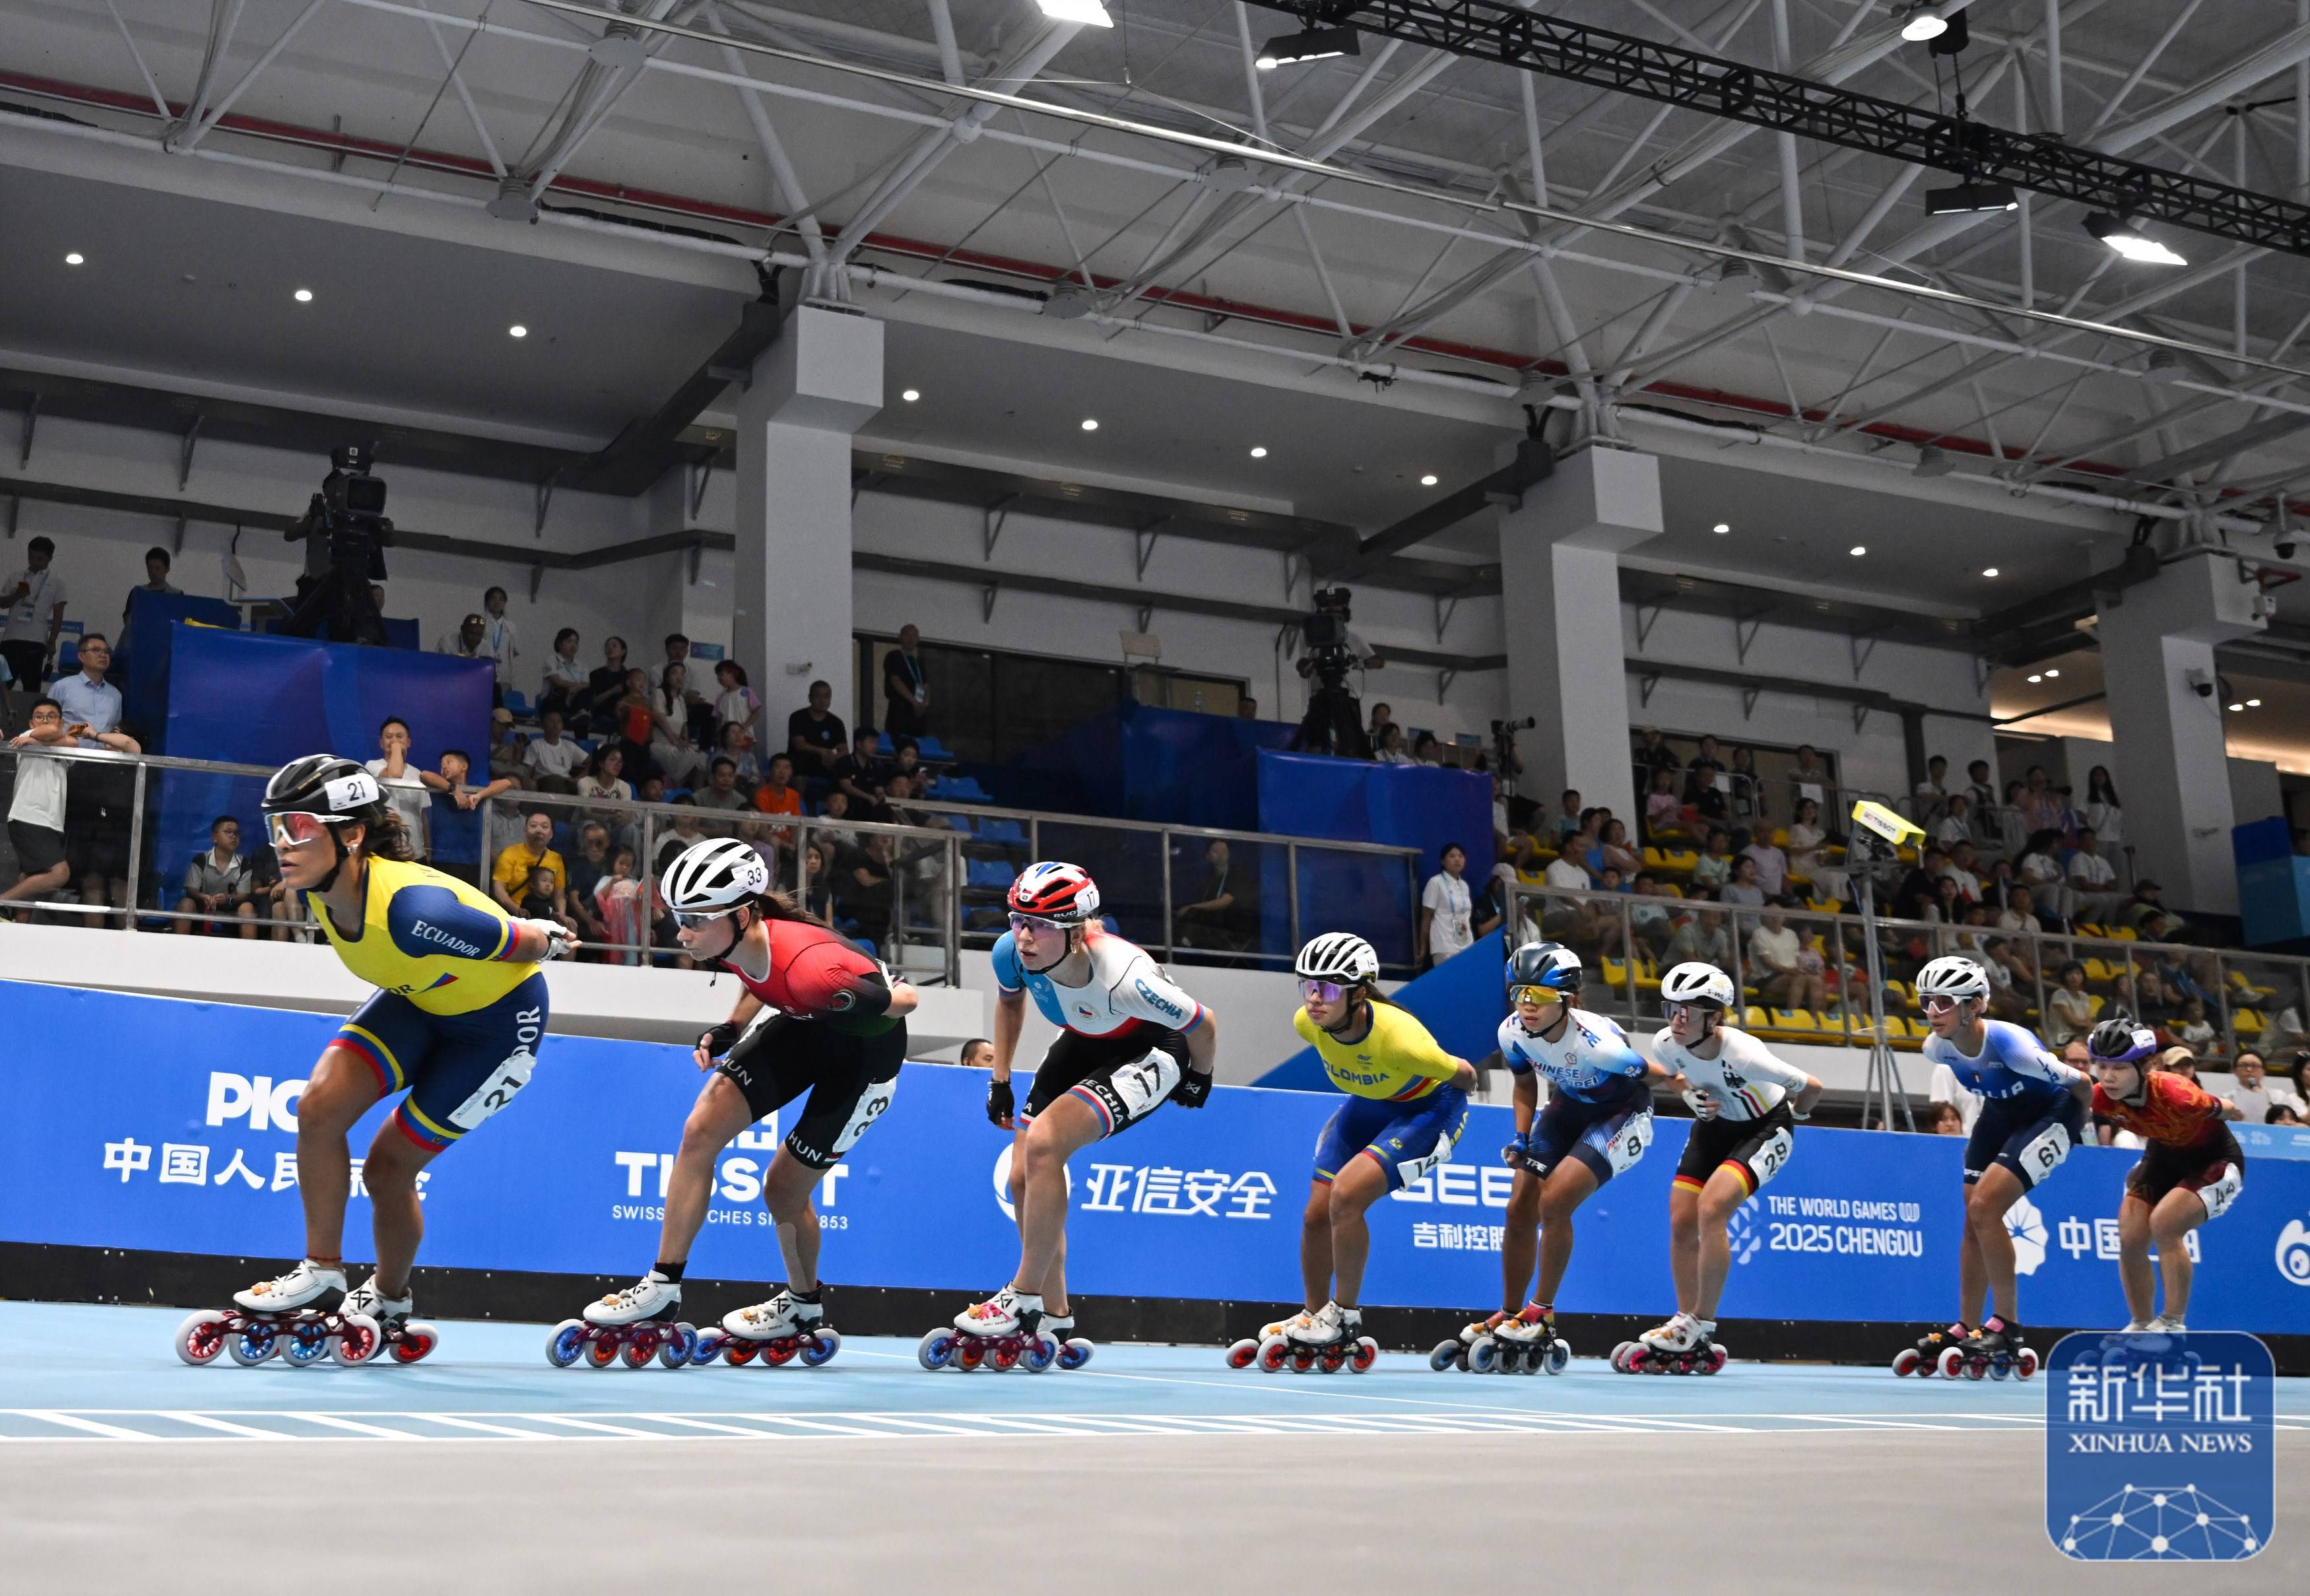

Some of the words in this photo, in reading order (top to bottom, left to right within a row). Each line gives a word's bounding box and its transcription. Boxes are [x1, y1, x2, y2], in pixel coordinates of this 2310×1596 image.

[347, 781, 366, 801] 21
[747, 867, 762, 886] 33
[1086, 890, 1096, 908] 17
[411, 919, 480, 956] ECUADOR
[1135, 978, 1183, 1020] CZECHIA
[722, 1057, 752, 1086] HUN
[1133, 1061, 1160, 1098] 17
[1323, 1059, 1391, 1085] OLOMBIA
[1526, 1057, 1579, 1079] CHINESE
[1552, 1075, 1598, 1088] TAIPEI
[205, 1071, 300, 1133] PIC
[484, 1075, 523, 1110] 21
[1078, 1079, 1123, 1125] ZECHIA
[1969, 1081, 2025, 1099] ALIA
[789, 1131, 822, 1162] HUN
[1627, 1135, 1642, 1157] 8
[2038, 1139, 2062, 1168] 61
[614, 1150, 849, 1207] TIST
[1414, 1156, 1439, 1178] 14
[1526, 1157, 1548, 1172] TPE
[1081, 1163, 1278, 1218] 亚信安全
[1390, 1163, 1516, 1207] GEE
[818, 1215, 849, 1229] 853
[1767, 1195, 1797, 1216] THE
[1799, 1197, 1850, 1218] WORLD
[1852, 1201, 1898, 1222] GAMES
[1769, 1222, 1833, 1253] 2025
[1835, 1226, 1923, 1257] CHENGDU
